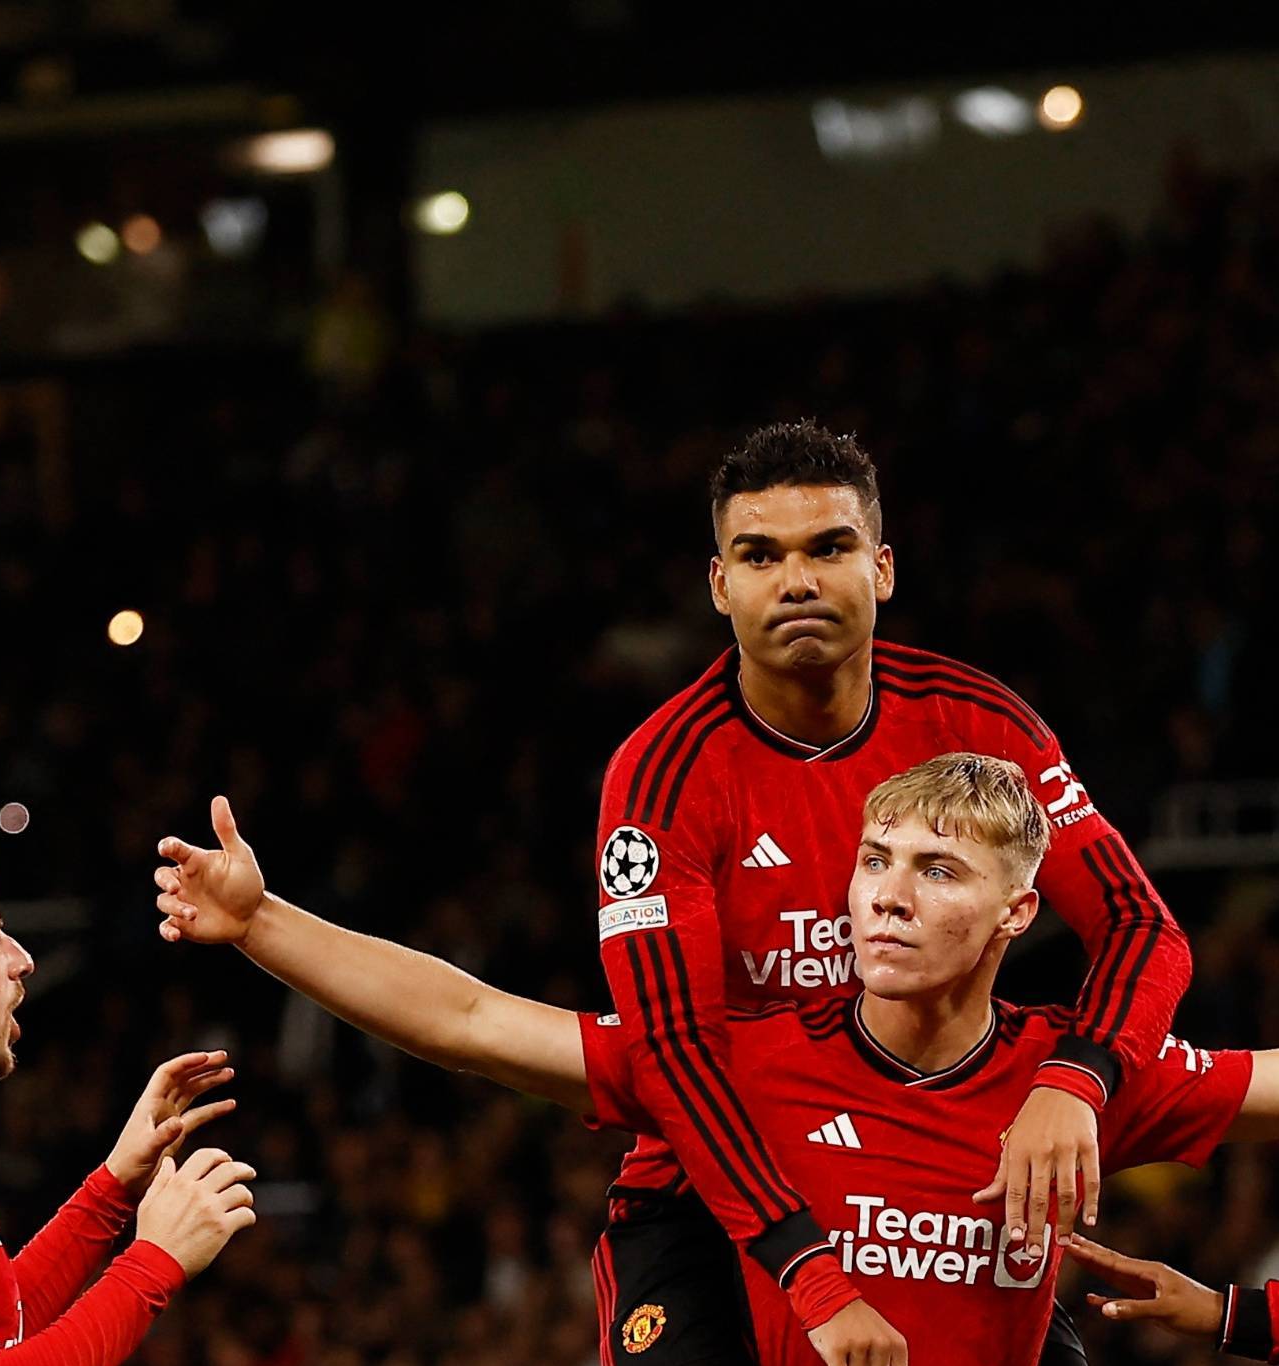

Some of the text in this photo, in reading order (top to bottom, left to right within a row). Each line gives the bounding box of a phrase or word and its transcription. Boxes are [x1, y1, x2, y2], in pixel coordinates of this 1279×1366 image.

[779, 909, 853, 953] Tea
[740, 948, 864, 988] View
[845, 1194, 993, 1250] Team
